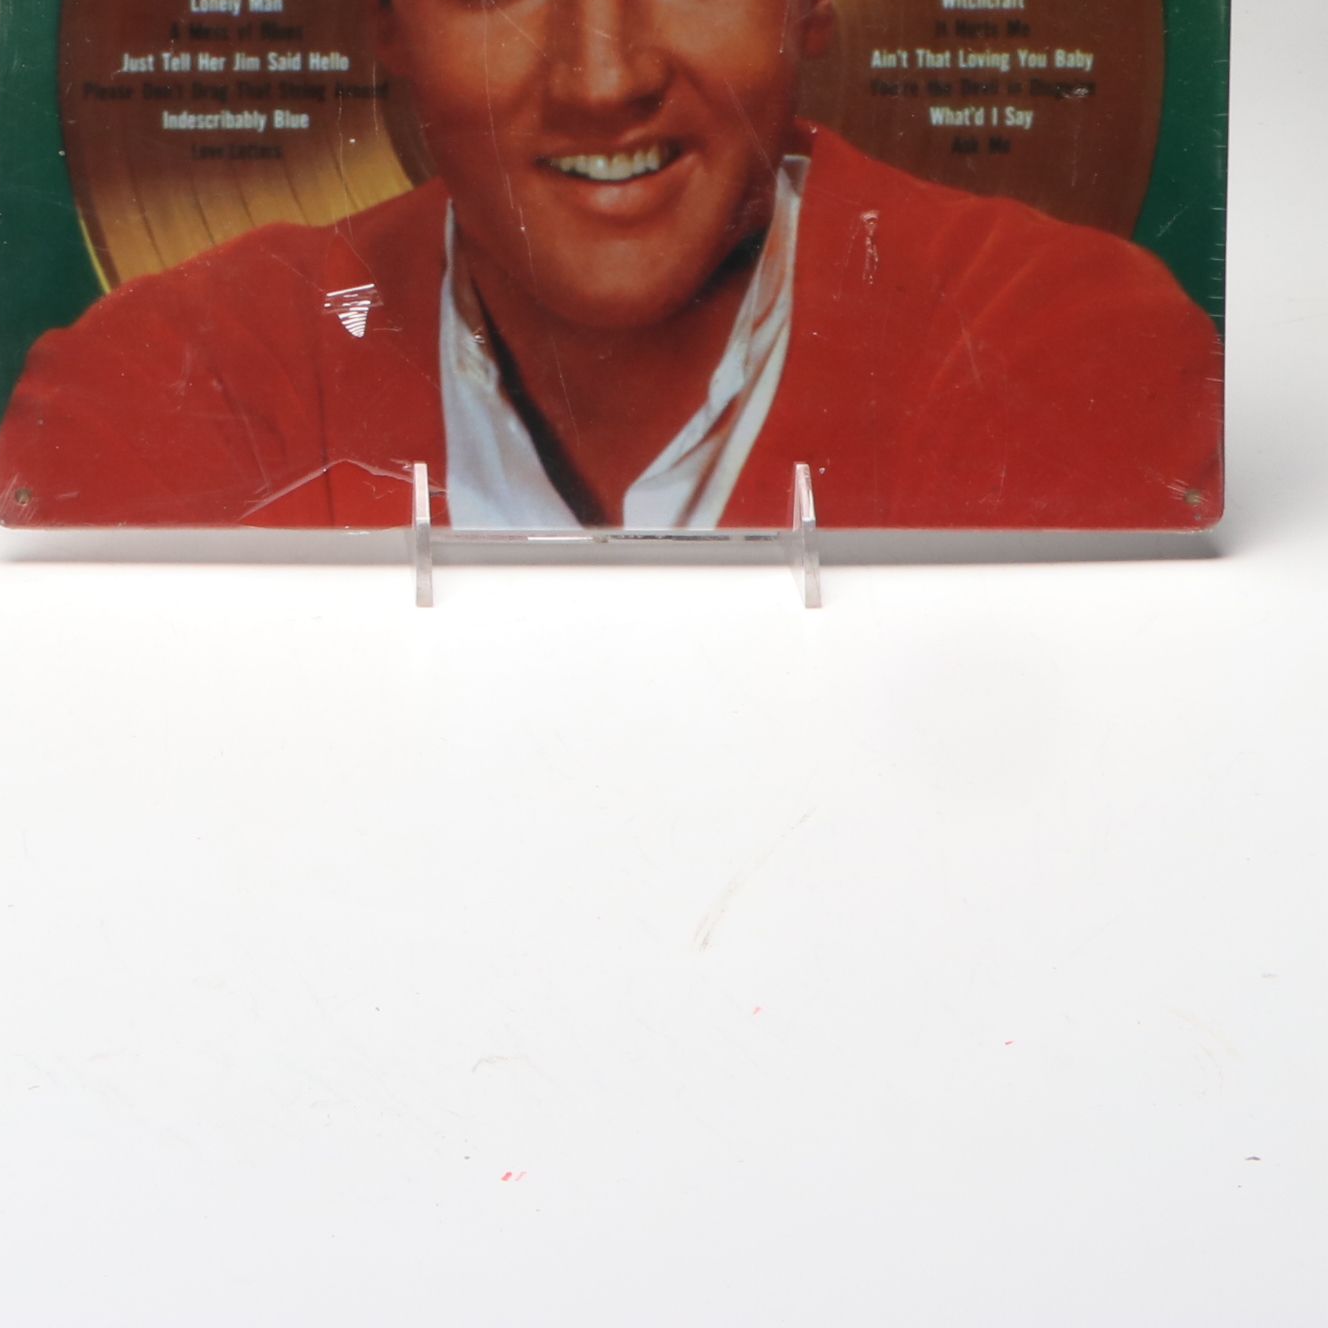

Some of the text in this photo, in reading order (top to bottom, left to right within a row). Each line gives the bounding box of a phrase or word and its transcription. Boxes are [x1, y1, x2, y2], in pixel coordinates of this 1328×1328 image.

[122, 51, 350, 73] Just Tell Her Jim Said Hello
[871, 48, 1095, 73] Ain't That Loving You Baby
[162, 109, 310, 133] Indescribably Blue
[929, 106, 1034, 130] What'd I Say
